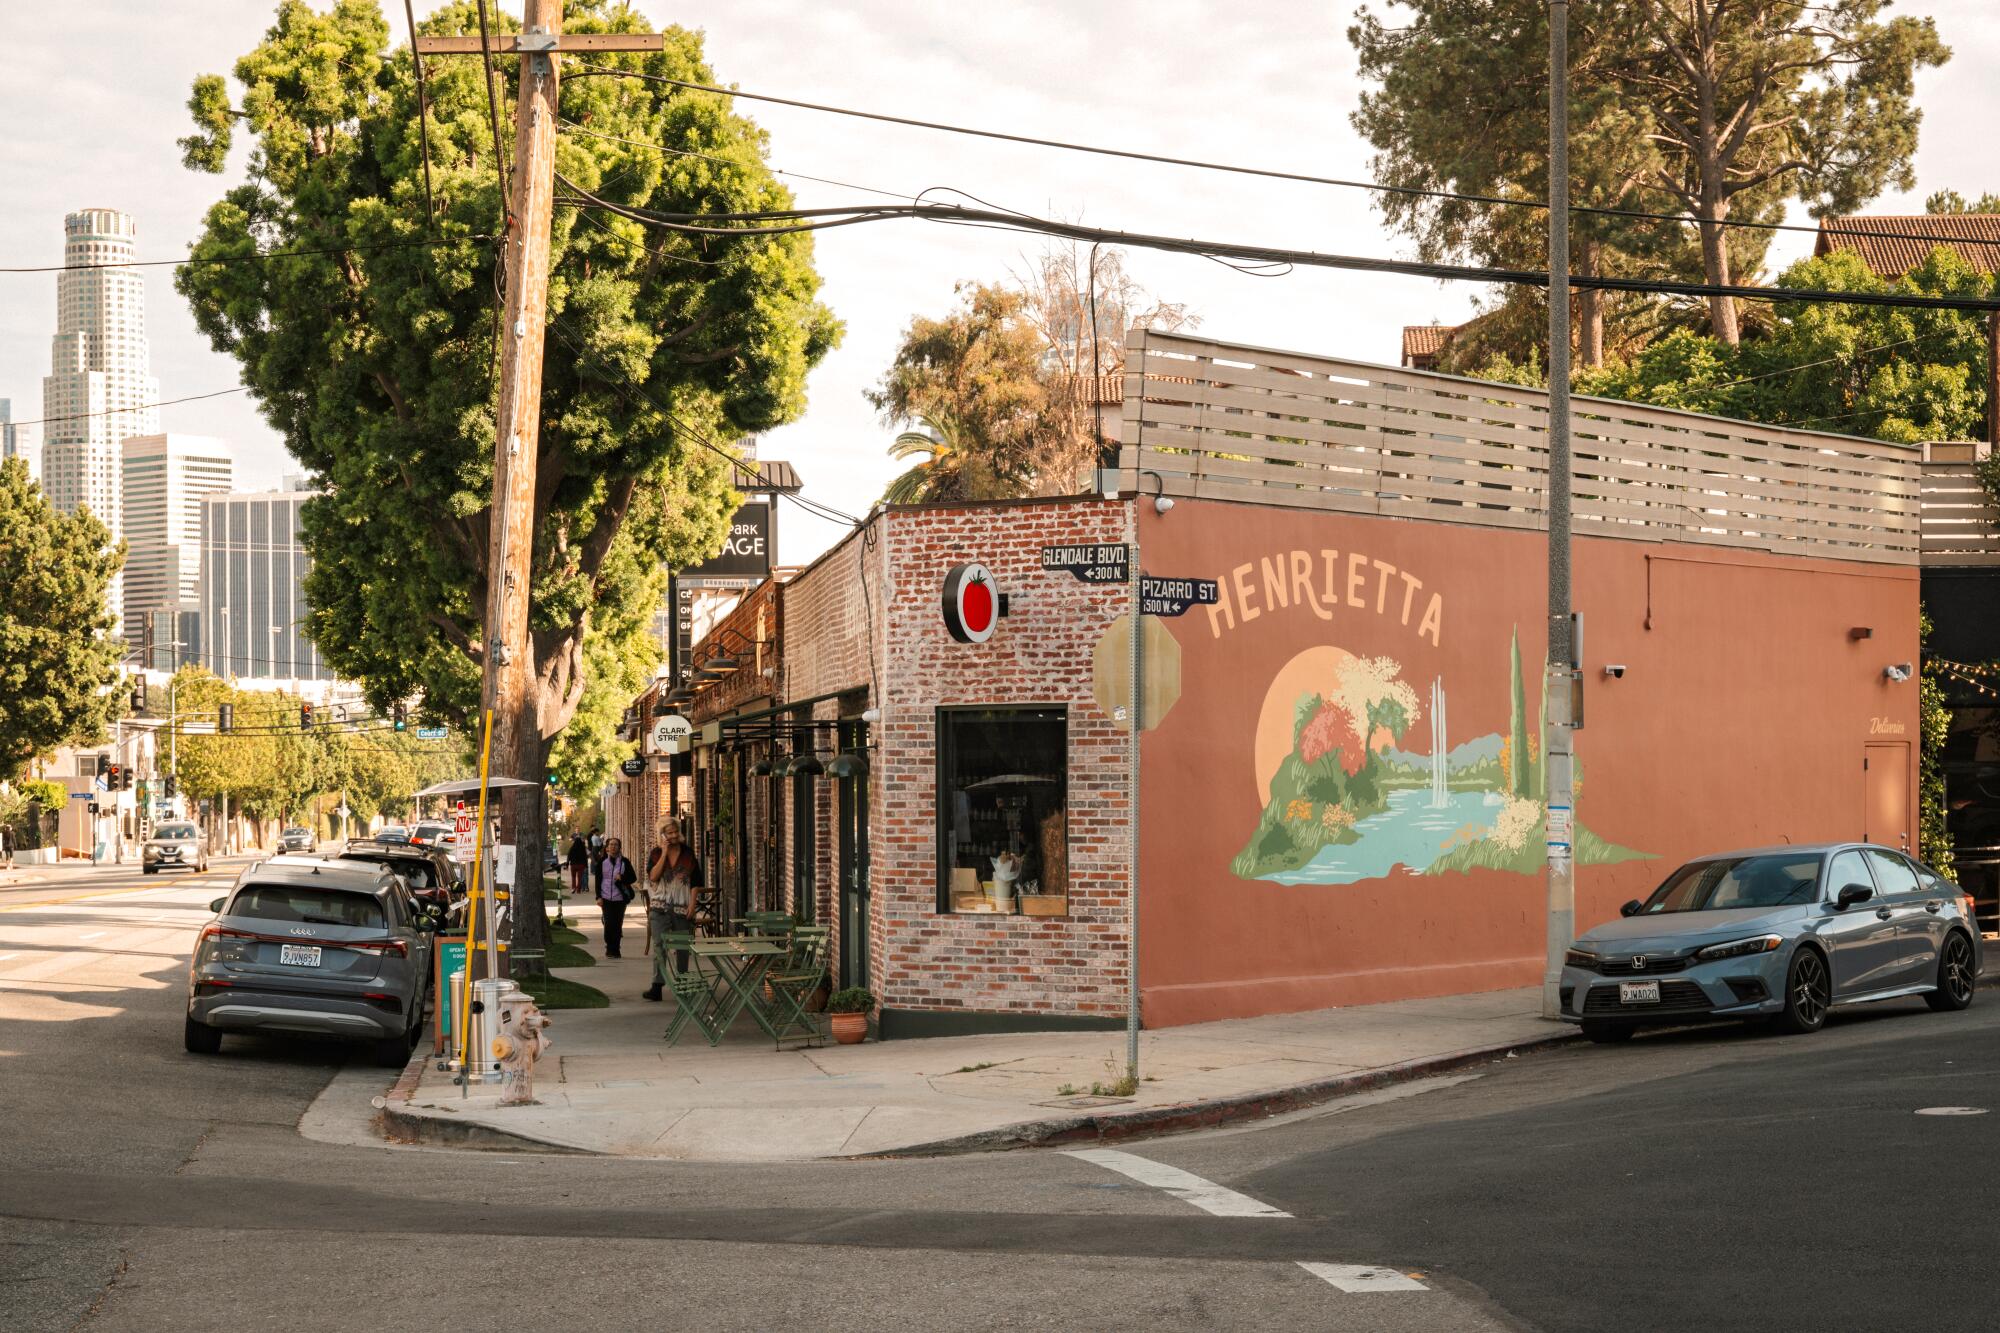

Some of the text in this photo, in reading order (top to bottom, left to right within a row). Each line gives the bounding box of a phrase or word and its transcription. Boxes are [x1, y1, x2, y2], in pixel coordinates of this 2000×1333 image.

[1042, 547, 1127, 566] GLENDALE BLVD.
[1095, 567, 1122, 580] 300 N.
[1142, 579, 1217, 600] PIZARRO ST.
[1206, 549, 1442, 647] HENRIETTA
[1162, 600, 1172, 613] W.
[1870, 716, 1905, 735] Deliveries
[458, 816, 471, 832] NO
[284, 951, 319, 963] 9JVN857
[1623, 989, 1657, 1000] 9JWA020
